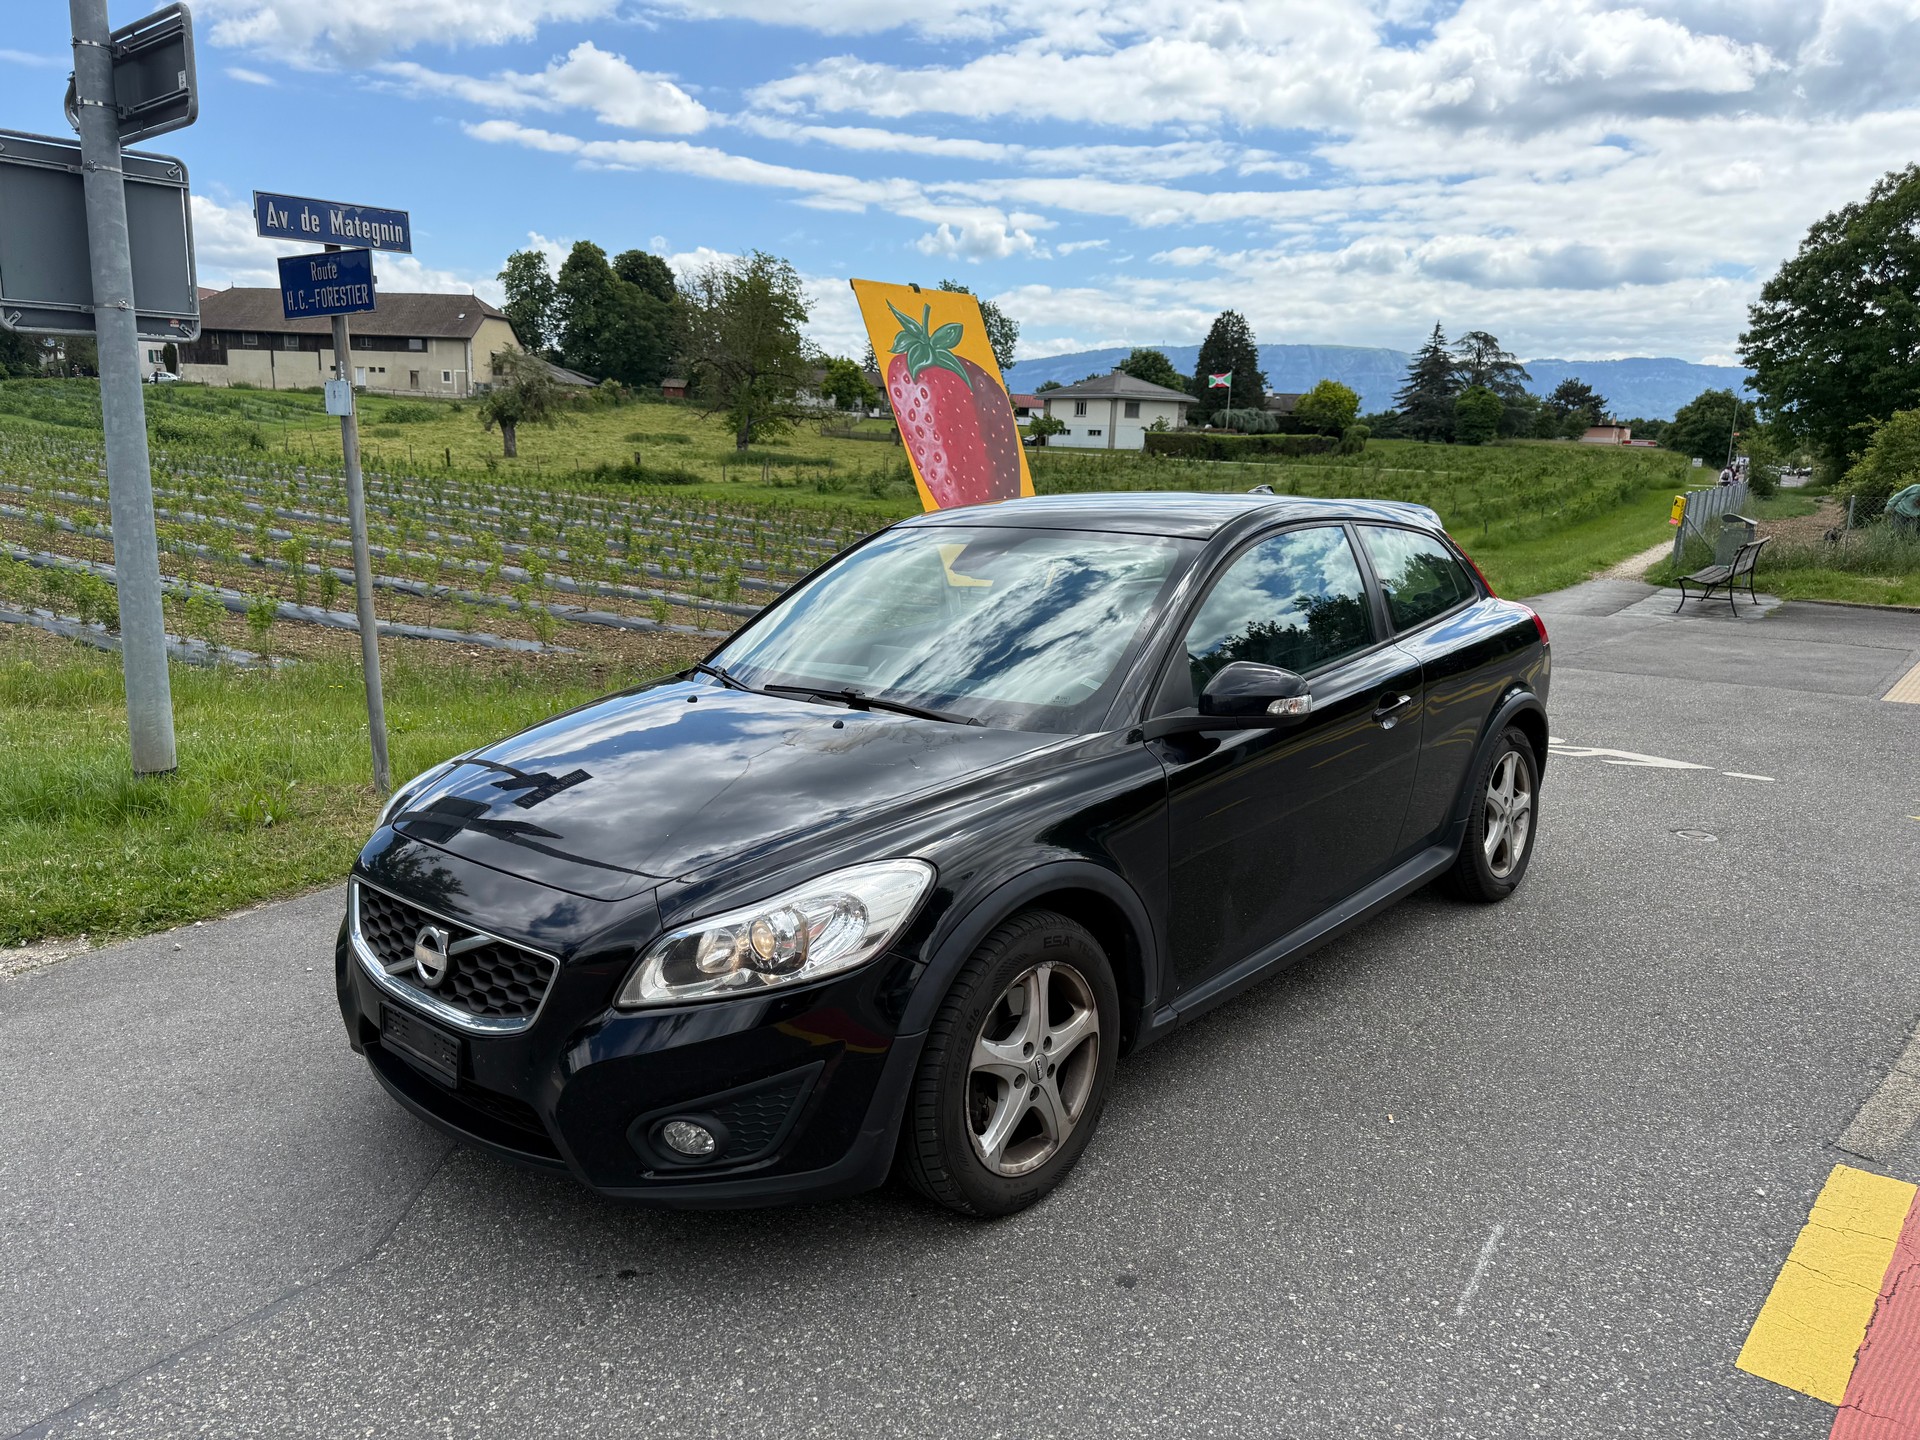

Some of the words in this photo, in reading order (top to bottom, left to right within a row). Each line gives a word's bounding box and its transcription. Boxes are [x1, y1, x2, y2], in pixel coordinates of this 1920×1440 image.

[266, 201, 294, 230] Av.
[300, 206, 321, 233] de
[329, 209, 404, 248] Mategnin
[310, 261, 338, 282] Route
[286, 283, 369, 311] H.C.-FORESTIER
